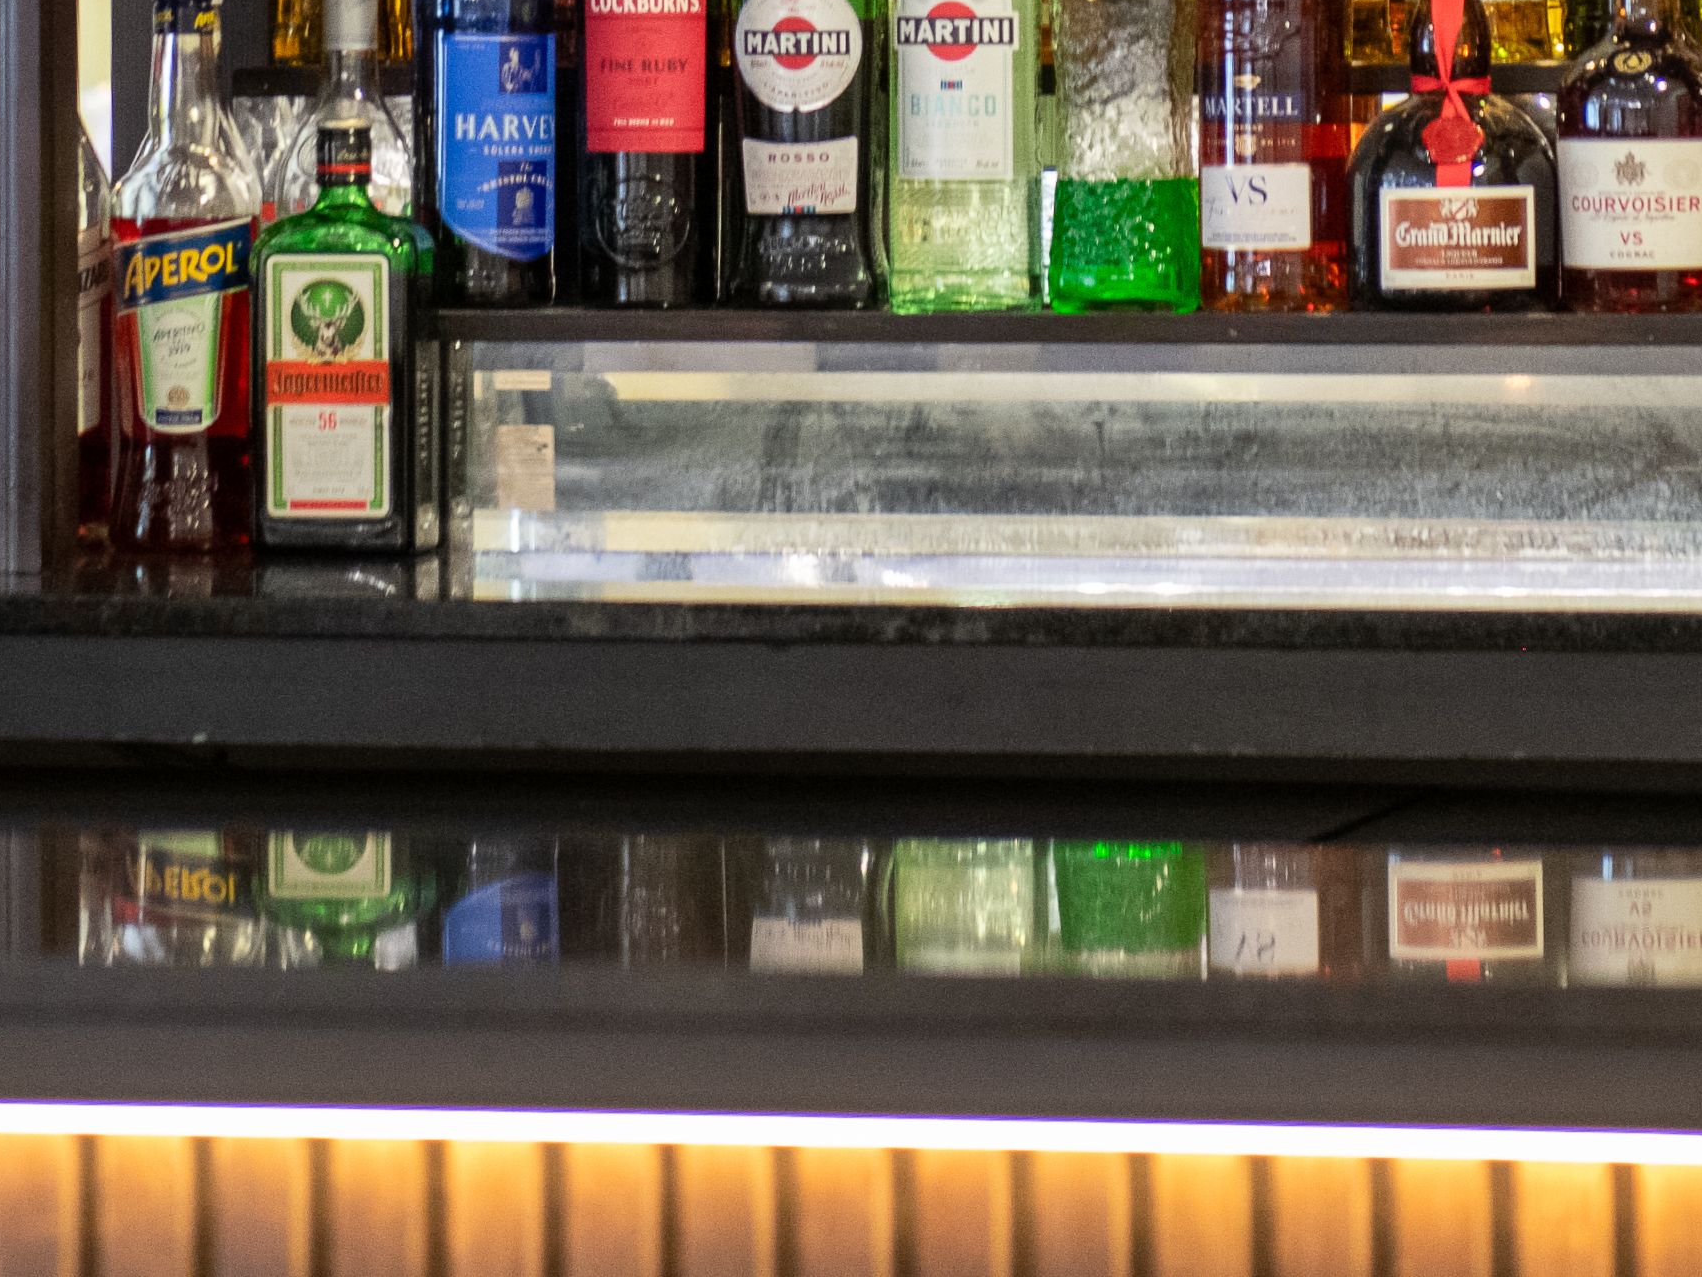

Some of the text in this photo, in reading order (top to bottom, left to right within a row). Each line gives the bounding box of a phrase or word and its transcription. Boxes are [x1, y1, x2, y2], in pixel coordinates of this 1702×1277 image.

[898, 19, 1011, 44] MARTINI
[747, 32, 847, 54] MARTINI
[599, 59, 688, 74] FINE RUBY
[911, 96, 997, 116] BIANCO
[1204, 96, 1298, 117] MARTELL
[768, 154, 830, 163] ROSSO
[1225, 173, 1268, 205] VS
[1572, 196, 1701, 213] COURVOISIER
[1620, 232, 1643, 246] VS
[124, 241, 235, 298] APEROL
